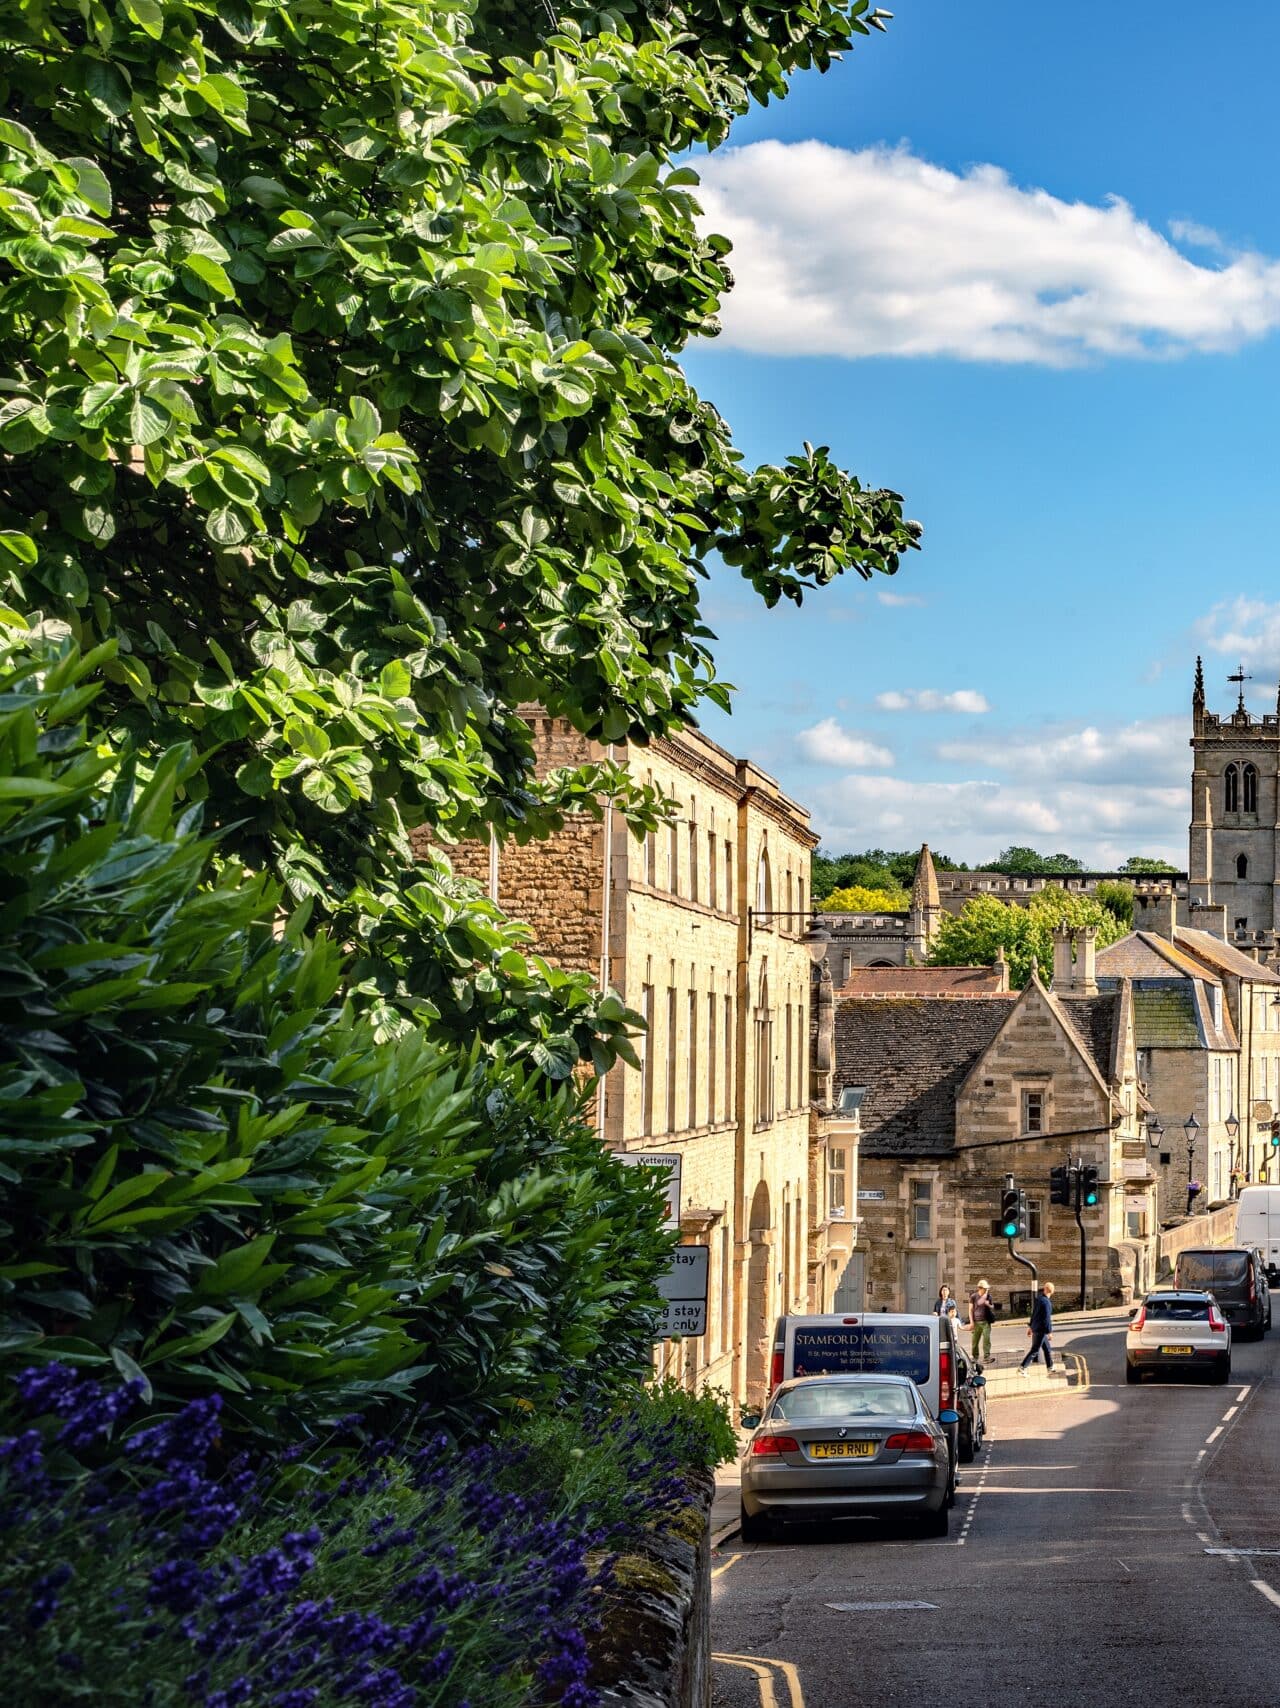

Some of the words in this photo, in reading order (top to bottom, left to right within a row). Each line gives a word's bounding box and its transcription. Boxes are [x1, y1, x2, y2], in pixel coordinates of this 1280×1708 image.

[639, 1156, 678, 1166] Kettering
[669, 1252, 696, 1266] stay
[674, 1306, 701, 1318] stay
[796, 1334, 859, 1345] STAMFORD
[862, 1334, 897, 1345] MUSIC
[900, 1334, 929, 1345] SHOP
[815, 1444, 844, 1456] FY56
[847, 1444, 869, 1454] RNU
